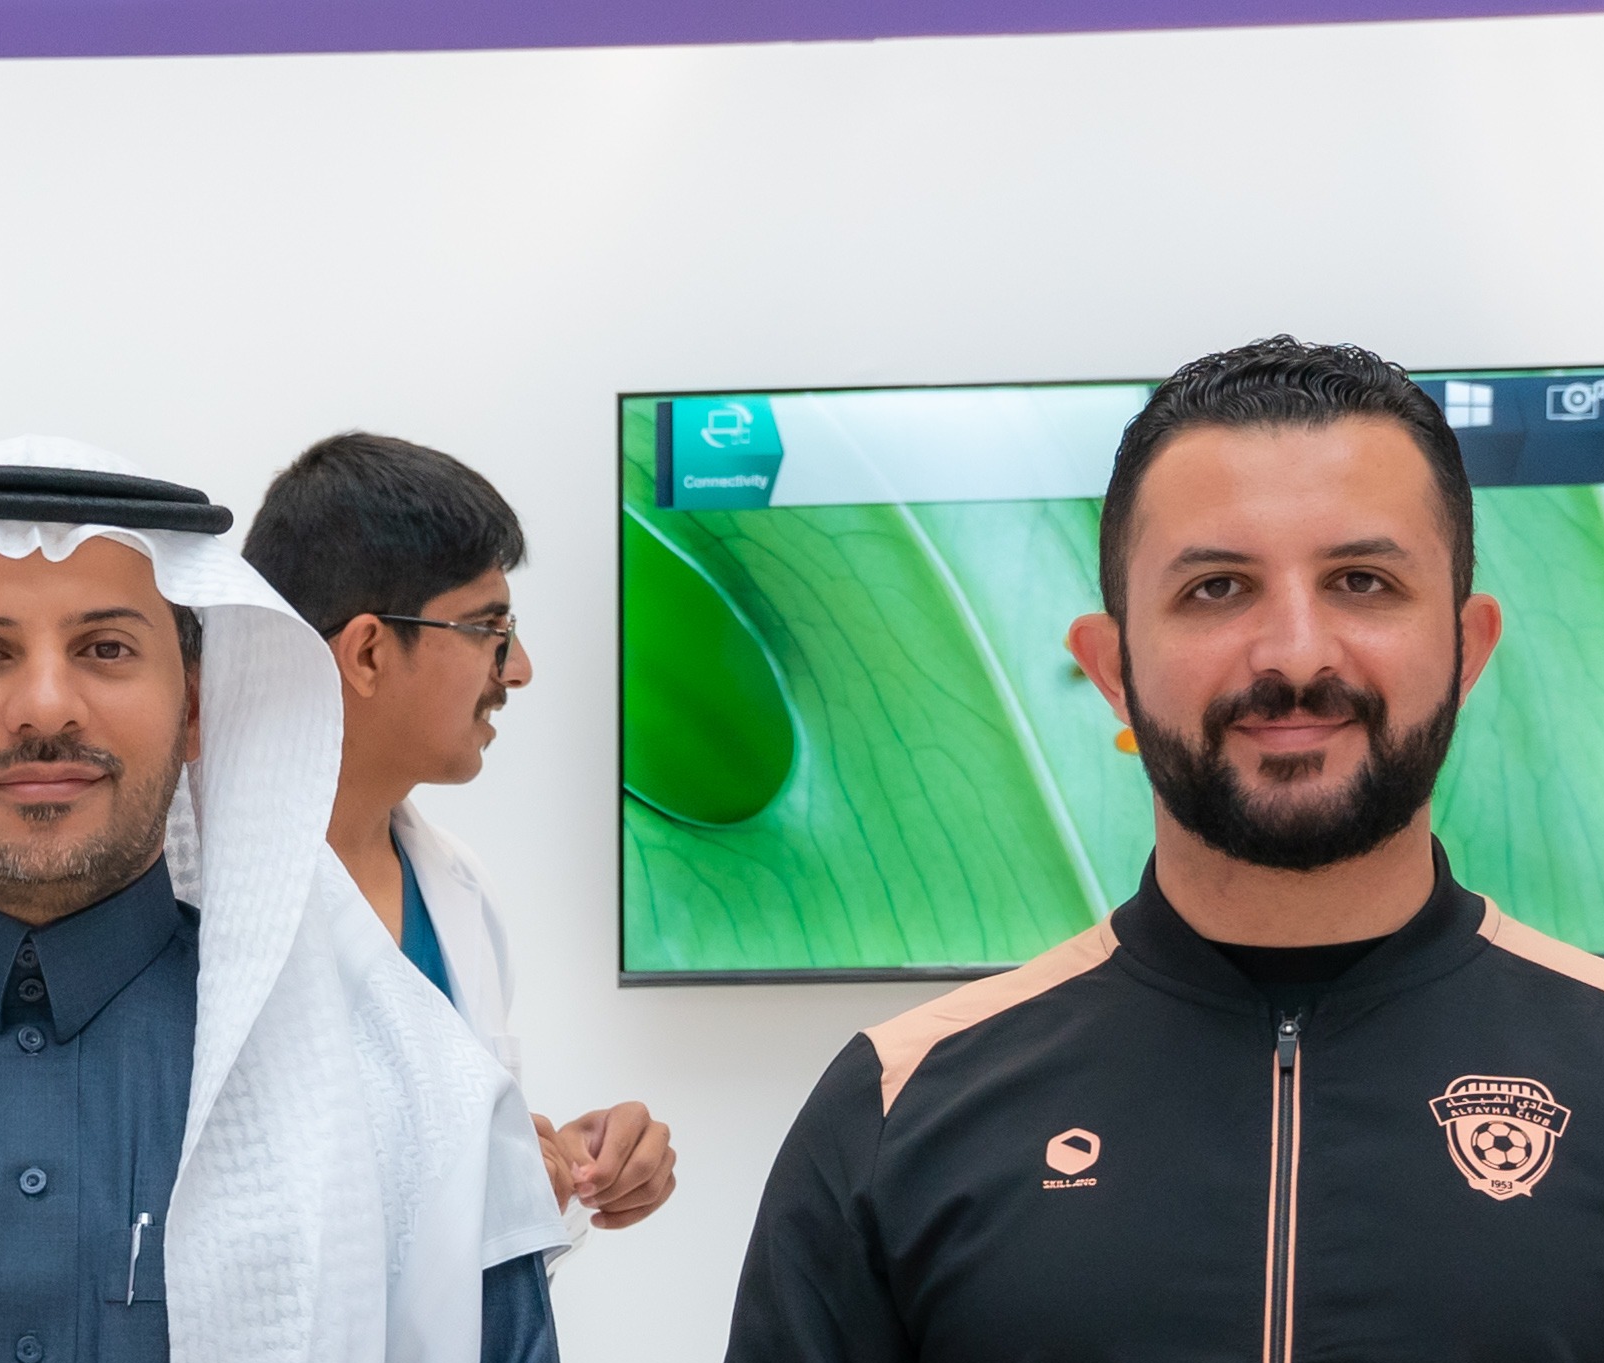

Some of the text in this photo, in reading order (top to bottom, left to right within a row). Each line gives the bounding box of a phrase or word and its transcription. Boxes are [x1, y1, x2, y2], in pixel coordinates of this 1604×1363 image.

[683, 474, 769, 490] Connectivity
[1445, 1095, 1557, 1116] نادي الفيحاء
[1450, 1106, 1552, 1127] ALFAYHA CLUB
[1491, 1180, 1513, 1190] 1953
